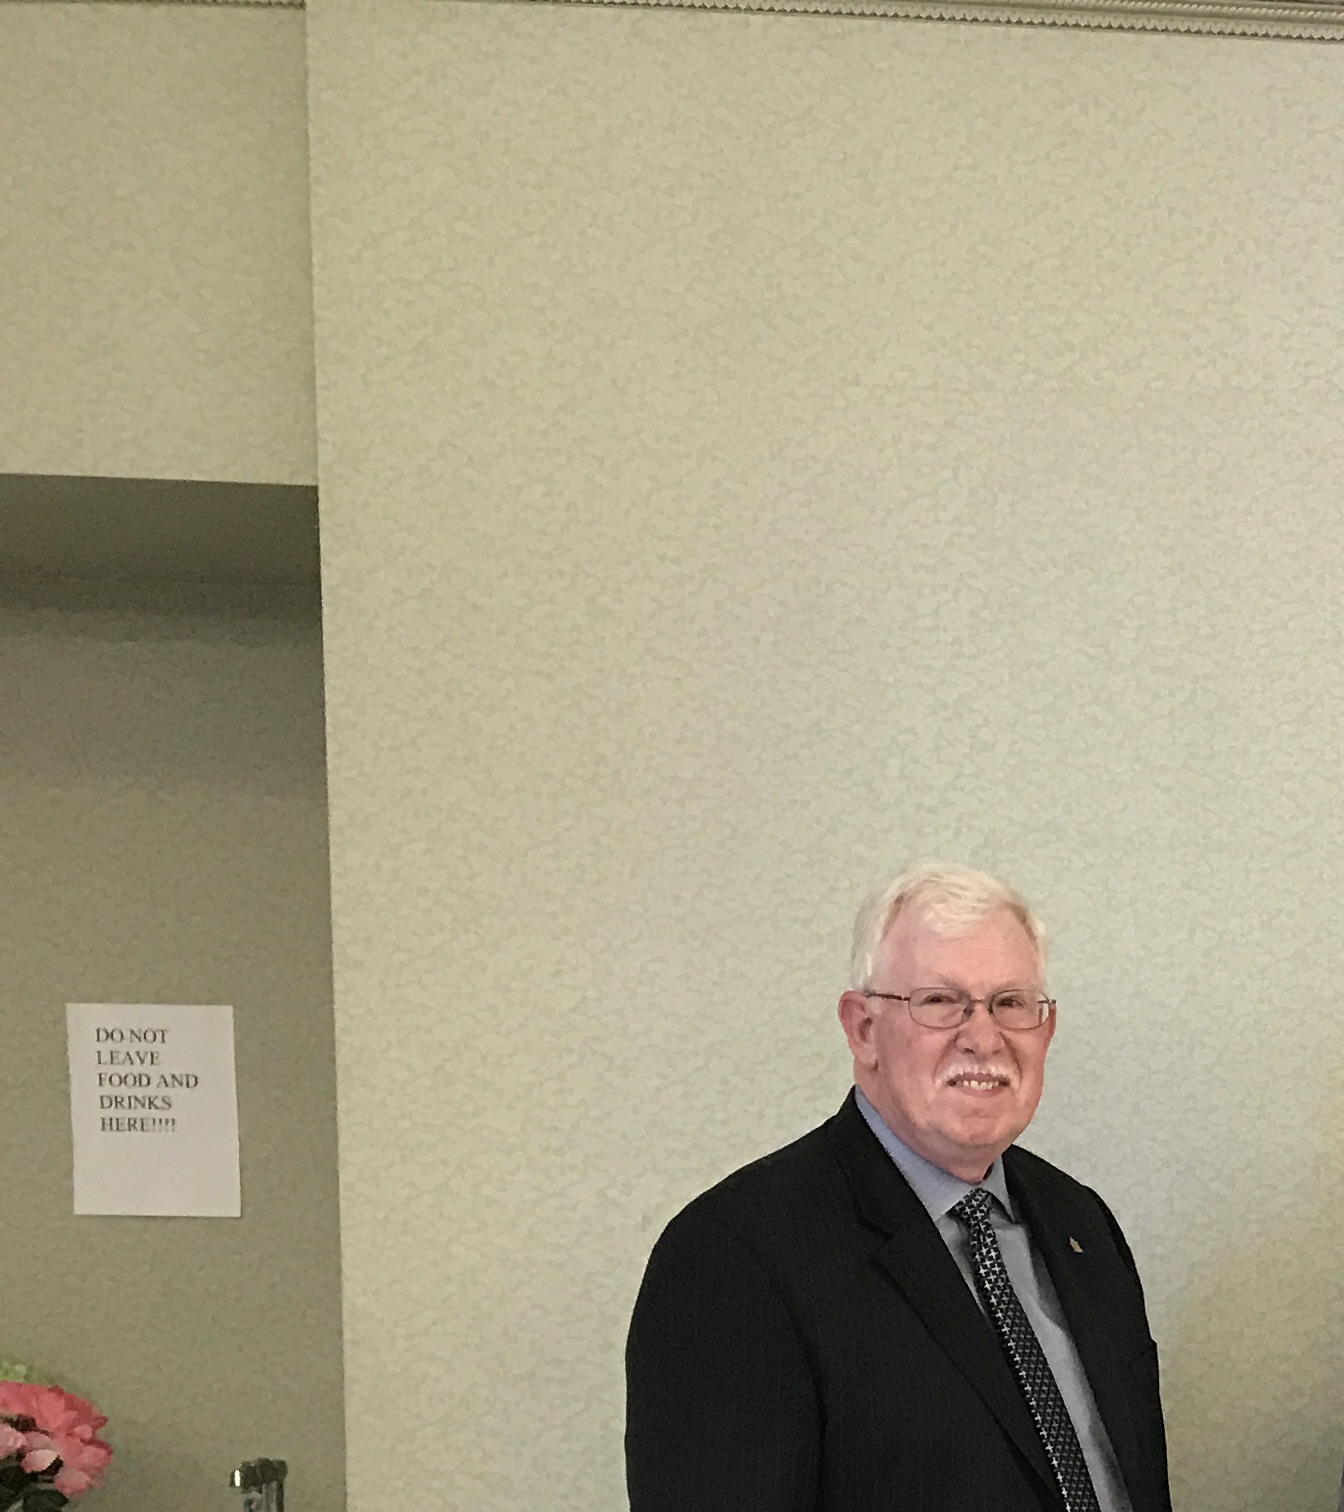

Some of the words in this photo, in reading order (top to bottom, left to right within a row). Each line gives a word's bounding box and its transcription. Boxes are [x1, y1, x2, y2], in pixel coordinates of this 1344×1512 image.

[95, 1027, 124, 1043] DO
[129, 1028, 169, 1044] NOT
[97, 1050, 161, 1066] LEAVE
[98, 1073, 151, 1088] FOOD
[156, 1074, 198, 1089] AND
[100, 1095, 173, 1111] DRINKS
[100, 1117, 176, 1133] HERE!!!!
